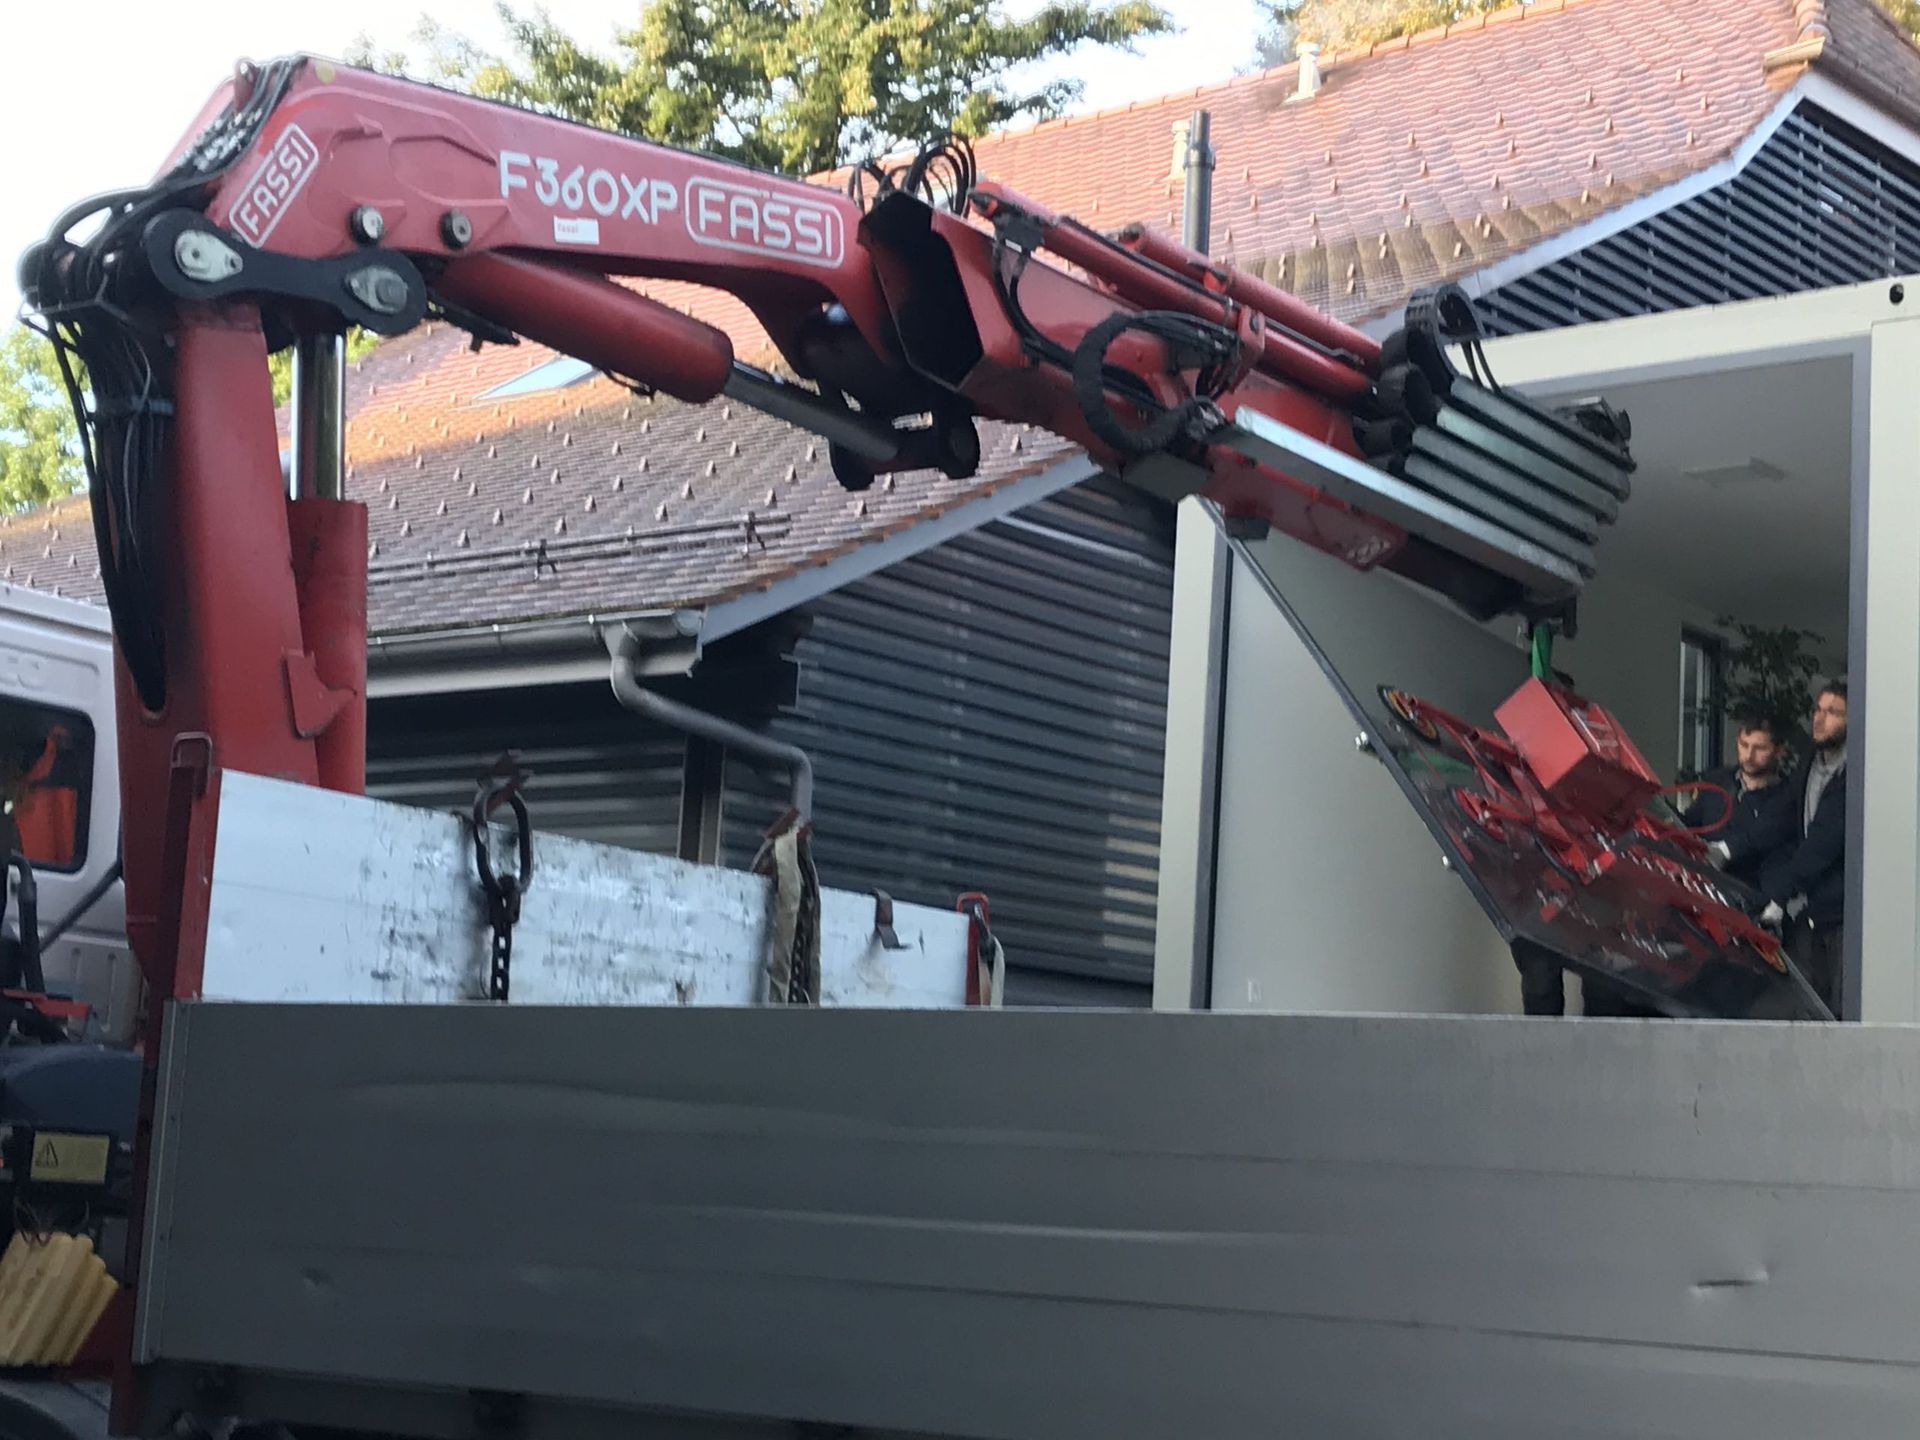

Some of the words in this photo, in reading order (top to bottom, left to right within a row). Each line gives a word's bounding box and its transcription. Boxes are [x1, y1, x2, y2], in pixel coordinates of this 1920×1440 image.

[240, 136, 309, 236] FASSI
[500, 151, 678, 225] F360XP
[699, 188, 832, 257] FASSI
